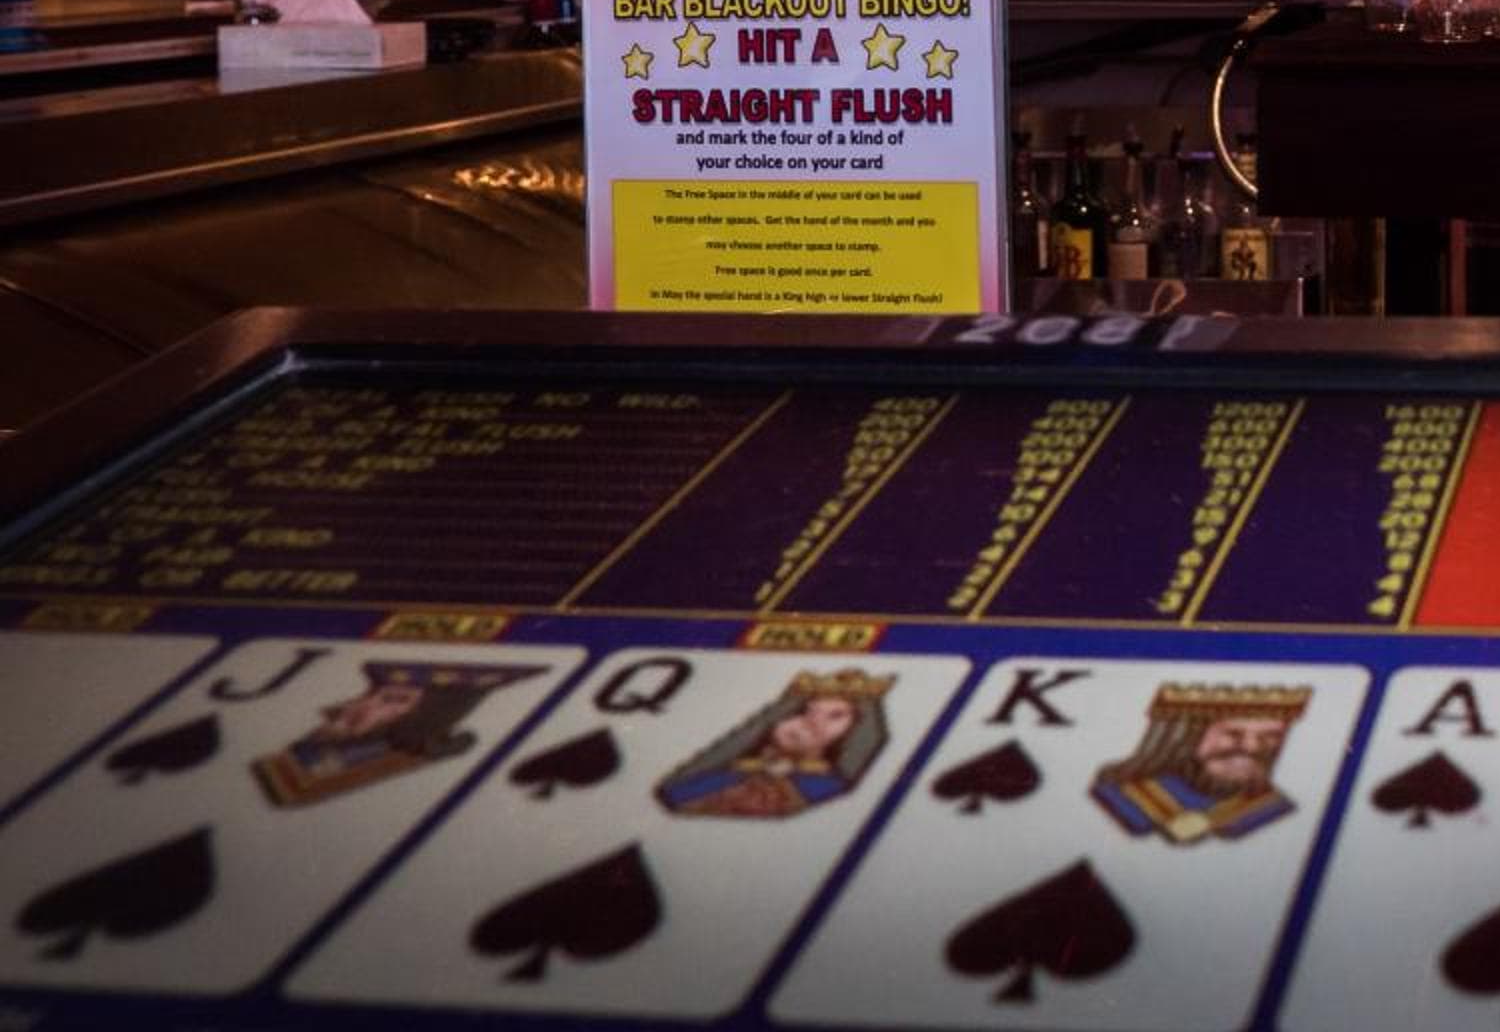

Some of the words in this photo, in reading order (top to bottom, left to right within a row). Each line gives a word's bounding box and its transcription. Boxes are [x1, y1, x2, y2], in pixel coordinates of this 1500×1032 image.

[737, 27, 801, 66] HIT
[811, 27, 841, 65] A
[631, 88, 821, 125] STRAIGHT
[830, 88, 954, 125] FLUSH
[676, 129, 704, 146] and
[708, 130, 748, 146] mark
[751, 129, 776, 146] the
[780, 129, 813, 146] four
[816, 129, 834, 146] of
[850, 129, 884, 146] kind
[887, 129, 904, 146] of
[696, 157, 731, 173] your
[735, 153, 784, 170] choice
[787, 157, 808, 170] on
[811, 157, 847, 173] your
[850, 153, 884, 171] card
[664, 189, 683, 199] The
[685, 189, 706, 199] Free
[708, 189, 736, 200] Space
[750, 189, 765, 199] the
[767, 189, 801, 200] middle
[816, 191, 838, 202] your
[840, 190, 862, 200] card
[864, 192, 881, 200] can
[898, 190, 922, 201] used
[697, 214, 723, 225] other
[765, 215, 783, 226] Get
[785, 215, 800, 225] the
[803, 215, 827, 226] hand
[842, 215, 859, 226] the
[861, 216, 894, 227] month
[896, 216, 915, 227] and
[917, 217, 936, 228] you
[706, 241, 727, 252] may
[765, 240, 804, 251] another
[805, 243, 833, 253] space
[715, 265, 737, 276] Free
[739, 267, 766, 278] space
[778, 266, 803, 278] good
[804, 268, 829, 277] once
[830, 268, 847, 279] per
[848, 267, 873, 278] card.
[662, 289, 684, 301] May
[685, 290, 701, 301] the
[703, 290, 735, 302] special
[738, 290, 763, 301] hand
[782, 291, 804, 304] King
[805, 292, 827, 304] high
[841, 292, 870, 302] lower
[1392, 421, 1459, 436] 800
[1382, 438, 1451, 453] 400
[1378, 455, 1447, 471] 200
[1379, 511, 1428, 529] 20
[1376, 573, 1404, 593] 4
[1366, 595, 1396, 617] 4
[399, 616, 499, 637] HOLD
[757, 627, 869, 647] HOLD
[208, 648, 333, 703] J
[594, 657, 693, 715] Q
[983, 669, 1099, 730] K
[1402, 680, 1498, 737] A
